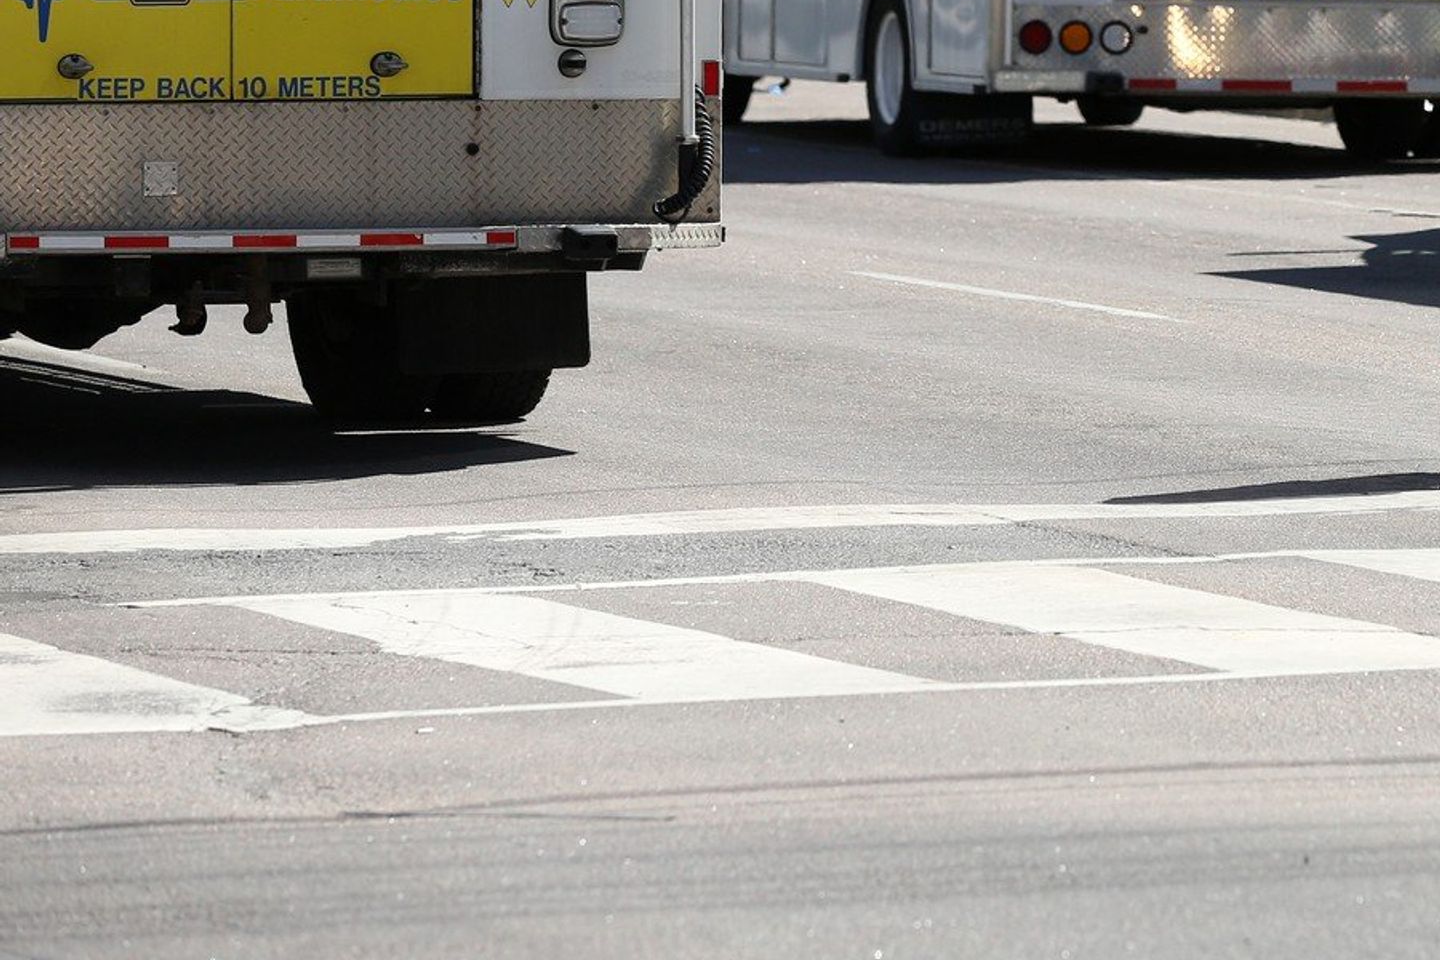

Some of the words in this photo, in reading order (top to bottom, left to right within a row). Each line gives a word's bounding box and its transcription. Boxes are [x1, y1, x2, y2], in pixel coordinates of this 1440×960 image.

[78, 78, 145, 99] KEEP
[157, 77, 225, 99] BACK
[238, 76, 267, 98] 10
[278, 76, 381, 98] METERS
